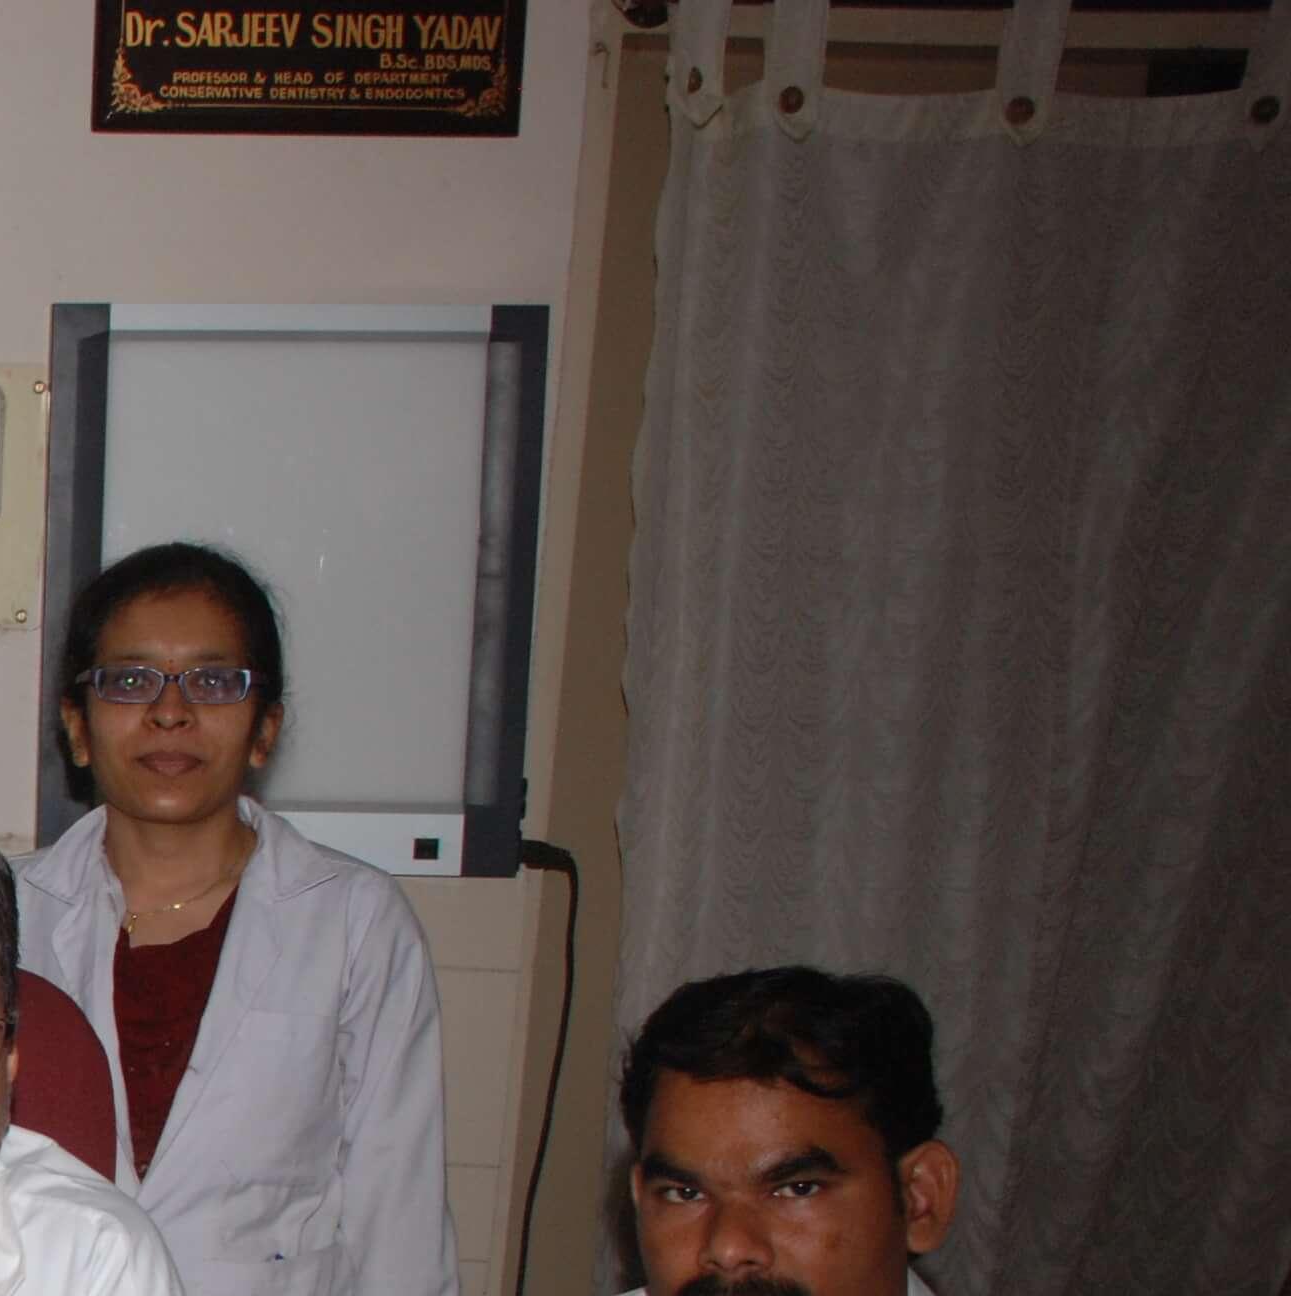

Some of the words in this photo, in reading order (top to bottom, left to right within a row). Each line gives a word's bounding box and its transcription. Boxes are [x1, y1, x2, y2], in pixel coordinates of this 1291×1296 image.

[175, 12, 300, 48] SARJEEV
[311, 13, 403, 49] SINGH
[416, 14, 502, 50] YADAV
[172, 71, 248, 85] PROFESSOR
[253, 71, 267, 84] &
[274, 71, 313, 85] HEAD
[323, 72, 344, 85] OF
[354, 71, 450, 86] DEPARTMENT
[159, 86, 263, 100] CONSERVATIVE
[269, 86, 345, 100] DENTISTRY
[348, 87, 361, 99] &
[365, 87, 467, 100] ENDODONTICS
